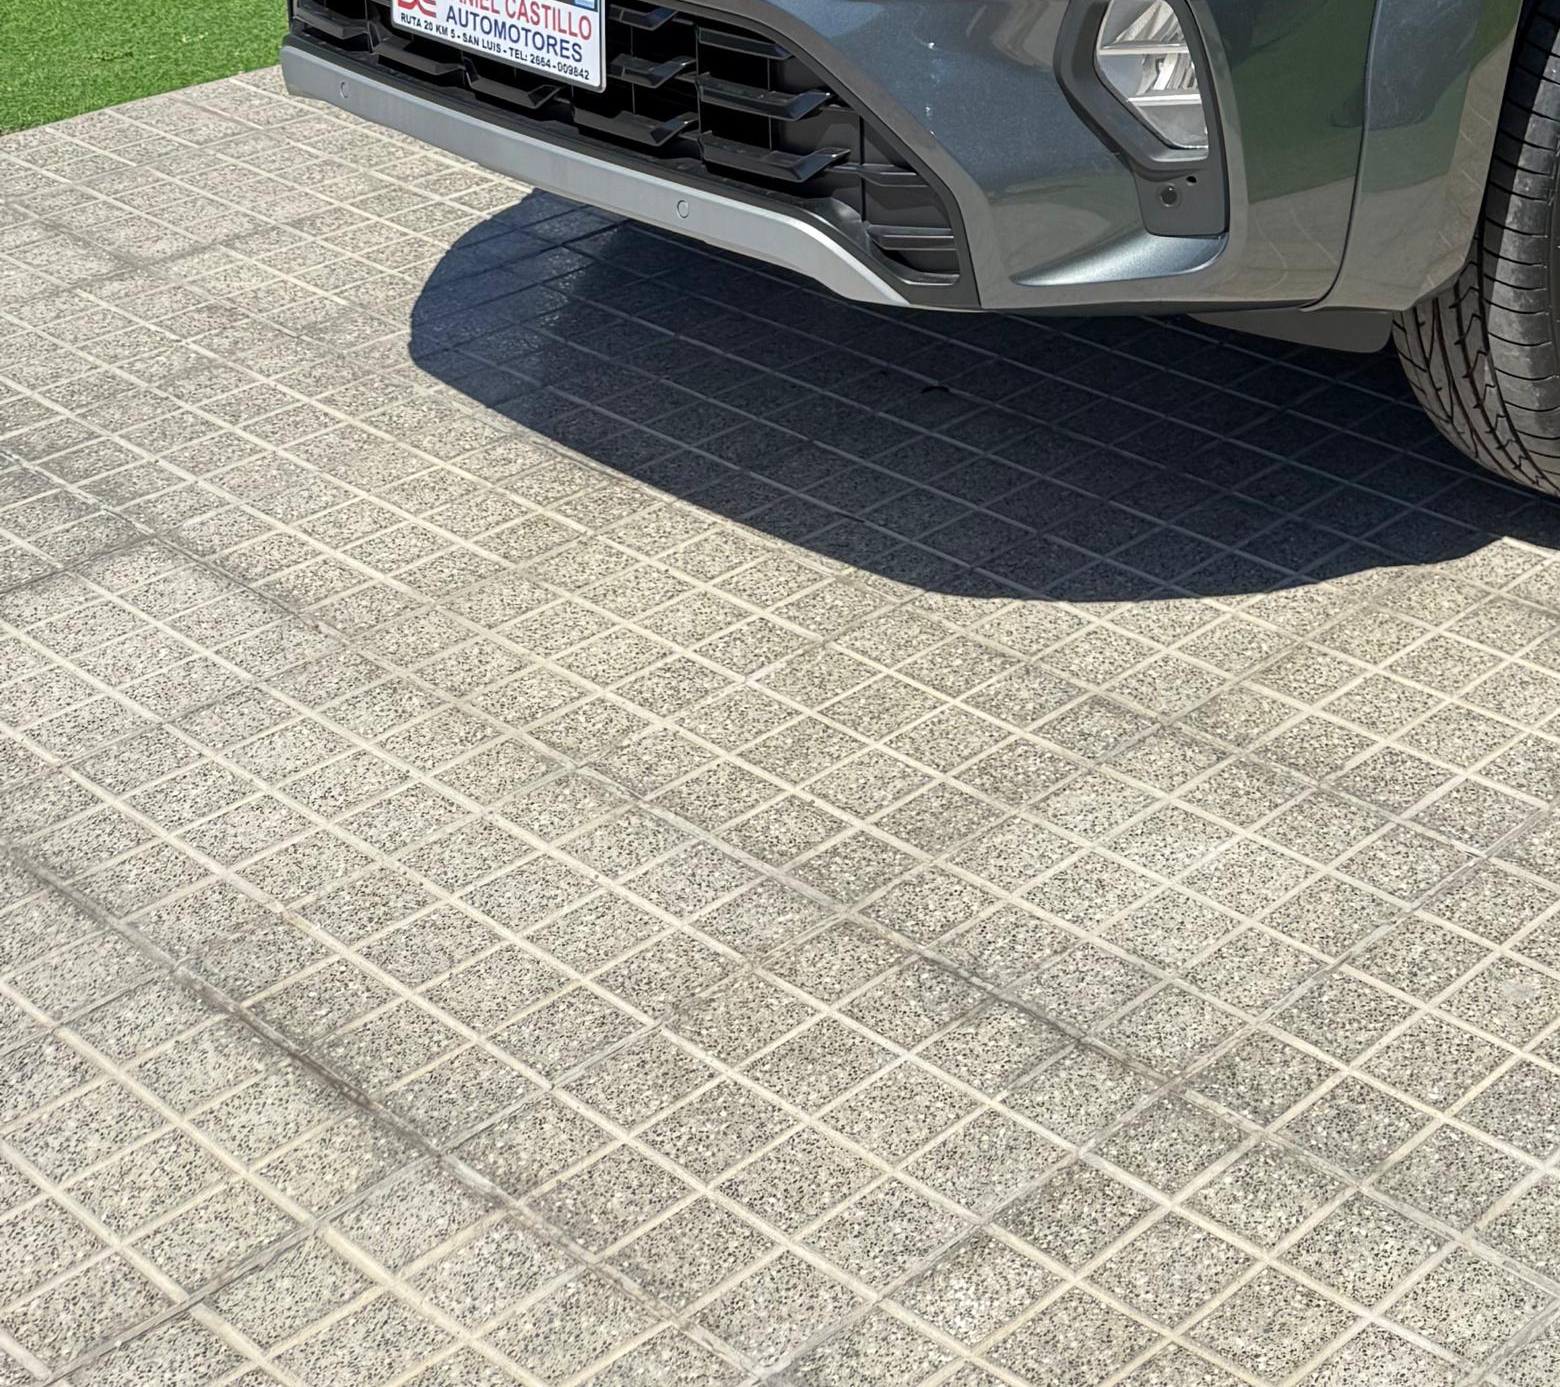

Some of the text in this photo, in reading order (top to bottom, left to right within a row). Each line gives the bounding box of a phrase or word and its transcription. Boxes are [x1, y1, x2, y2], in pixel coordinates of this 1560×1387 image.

[401, 12, 421, 27] RUTA
[436, 24, 448, 36] KM
[462, 33, 479, 46] SAN
[482, 39, 501, 53] LUIS
[509, 47, 528, 61] TEL:
[446, 5, 583, 63] AUTOMOTORES
